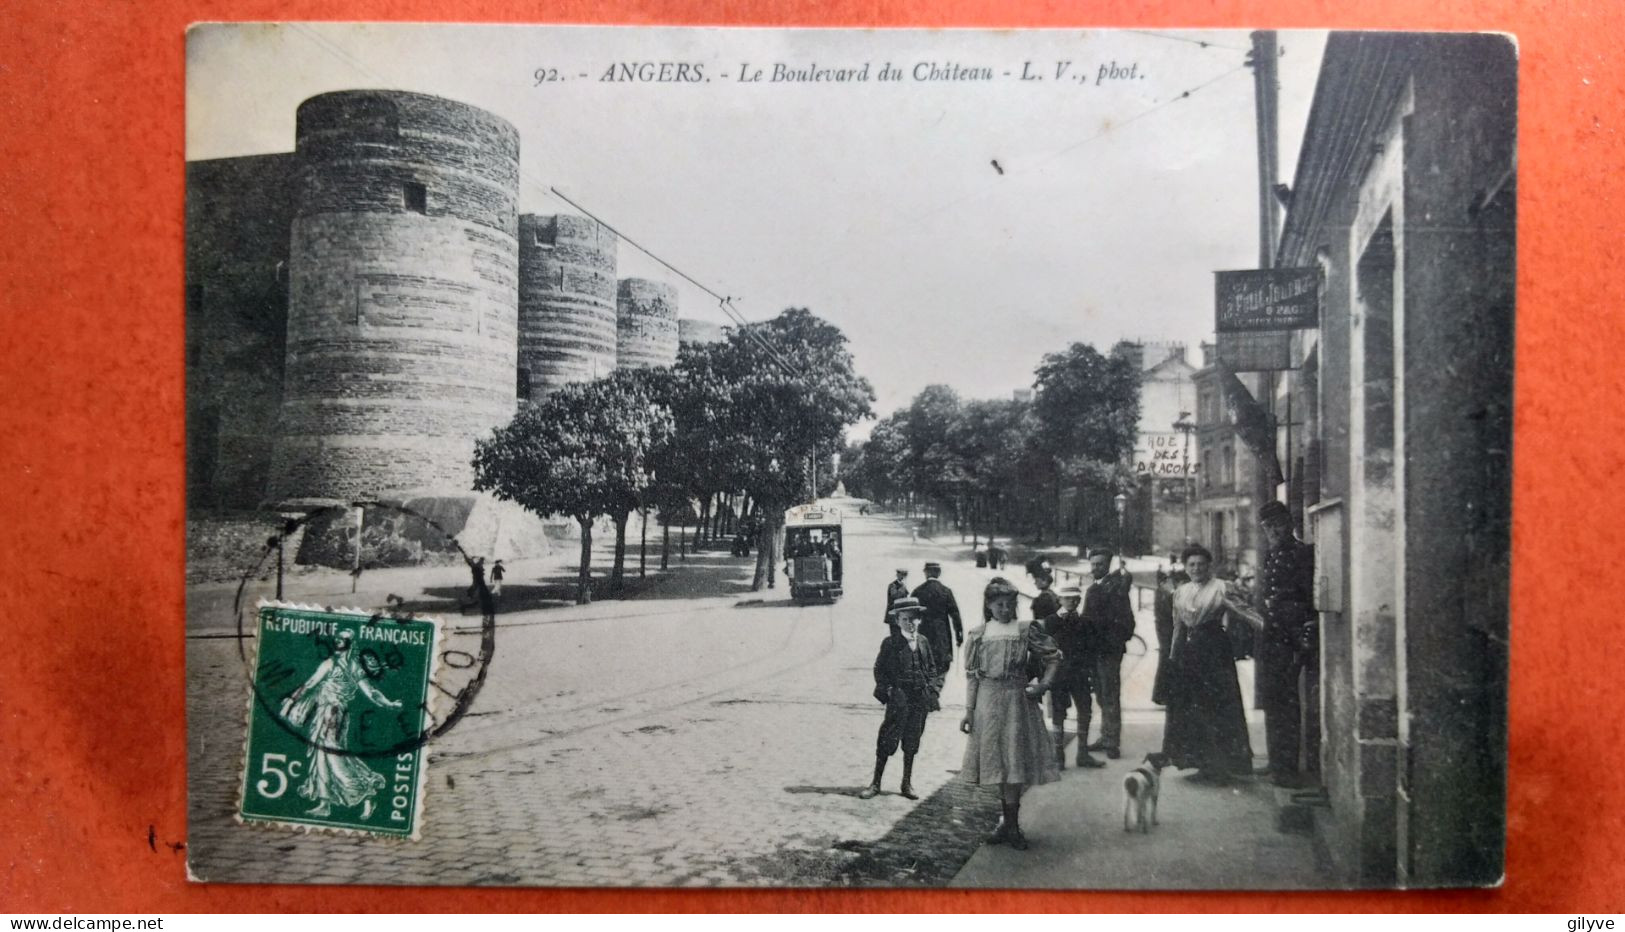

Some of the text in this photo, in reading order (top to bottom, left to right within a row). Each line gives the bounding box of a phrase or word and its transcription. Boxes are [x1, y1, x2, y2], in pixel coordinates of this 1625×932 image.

[534, 69, 565, 86] 92.
[599, 63, 711, 83] ANGERS.
[738, 63, 763, 83] Le
[770, 63, 869, 83] Boulevard
[878, 63, 902, 82] du
[912, 62, 993, 82] Château
[1021, 61, 1043, 81] L.
[1056, 61, 1086, 84] V.,
[1096, 61, 1145, 85] phot.
[359, 625, 425, 646] FRANÇAISE
[390, 752, 413, 821] POSTES
